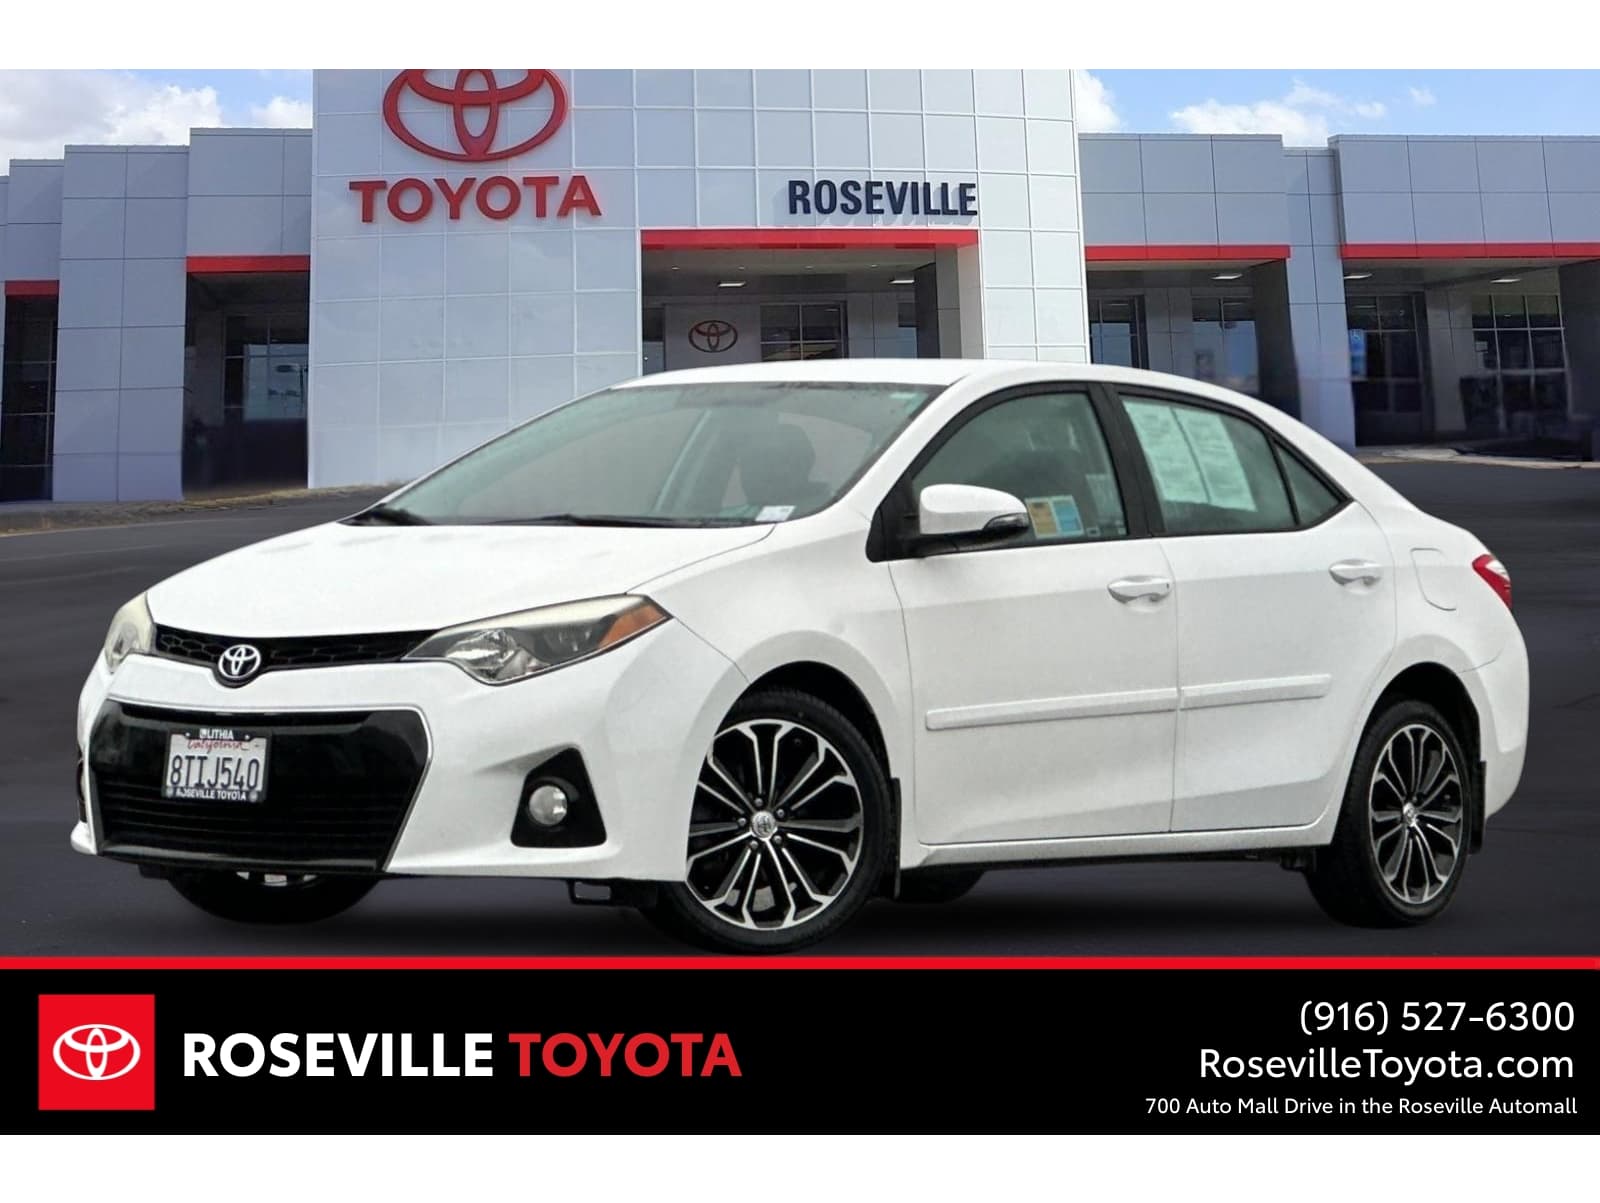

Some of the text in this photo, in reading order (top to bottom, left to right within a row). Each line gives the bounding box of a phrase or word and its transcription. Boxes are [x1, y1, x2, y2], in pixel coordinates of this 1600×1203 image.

[349, 175, 602, 223] TOYOTA
[788, 179, 979, 217] ROSEVILLE
[171, 754, 260, 790] 8TIJ540
[217, 790, 246, 801] TOYOTA
